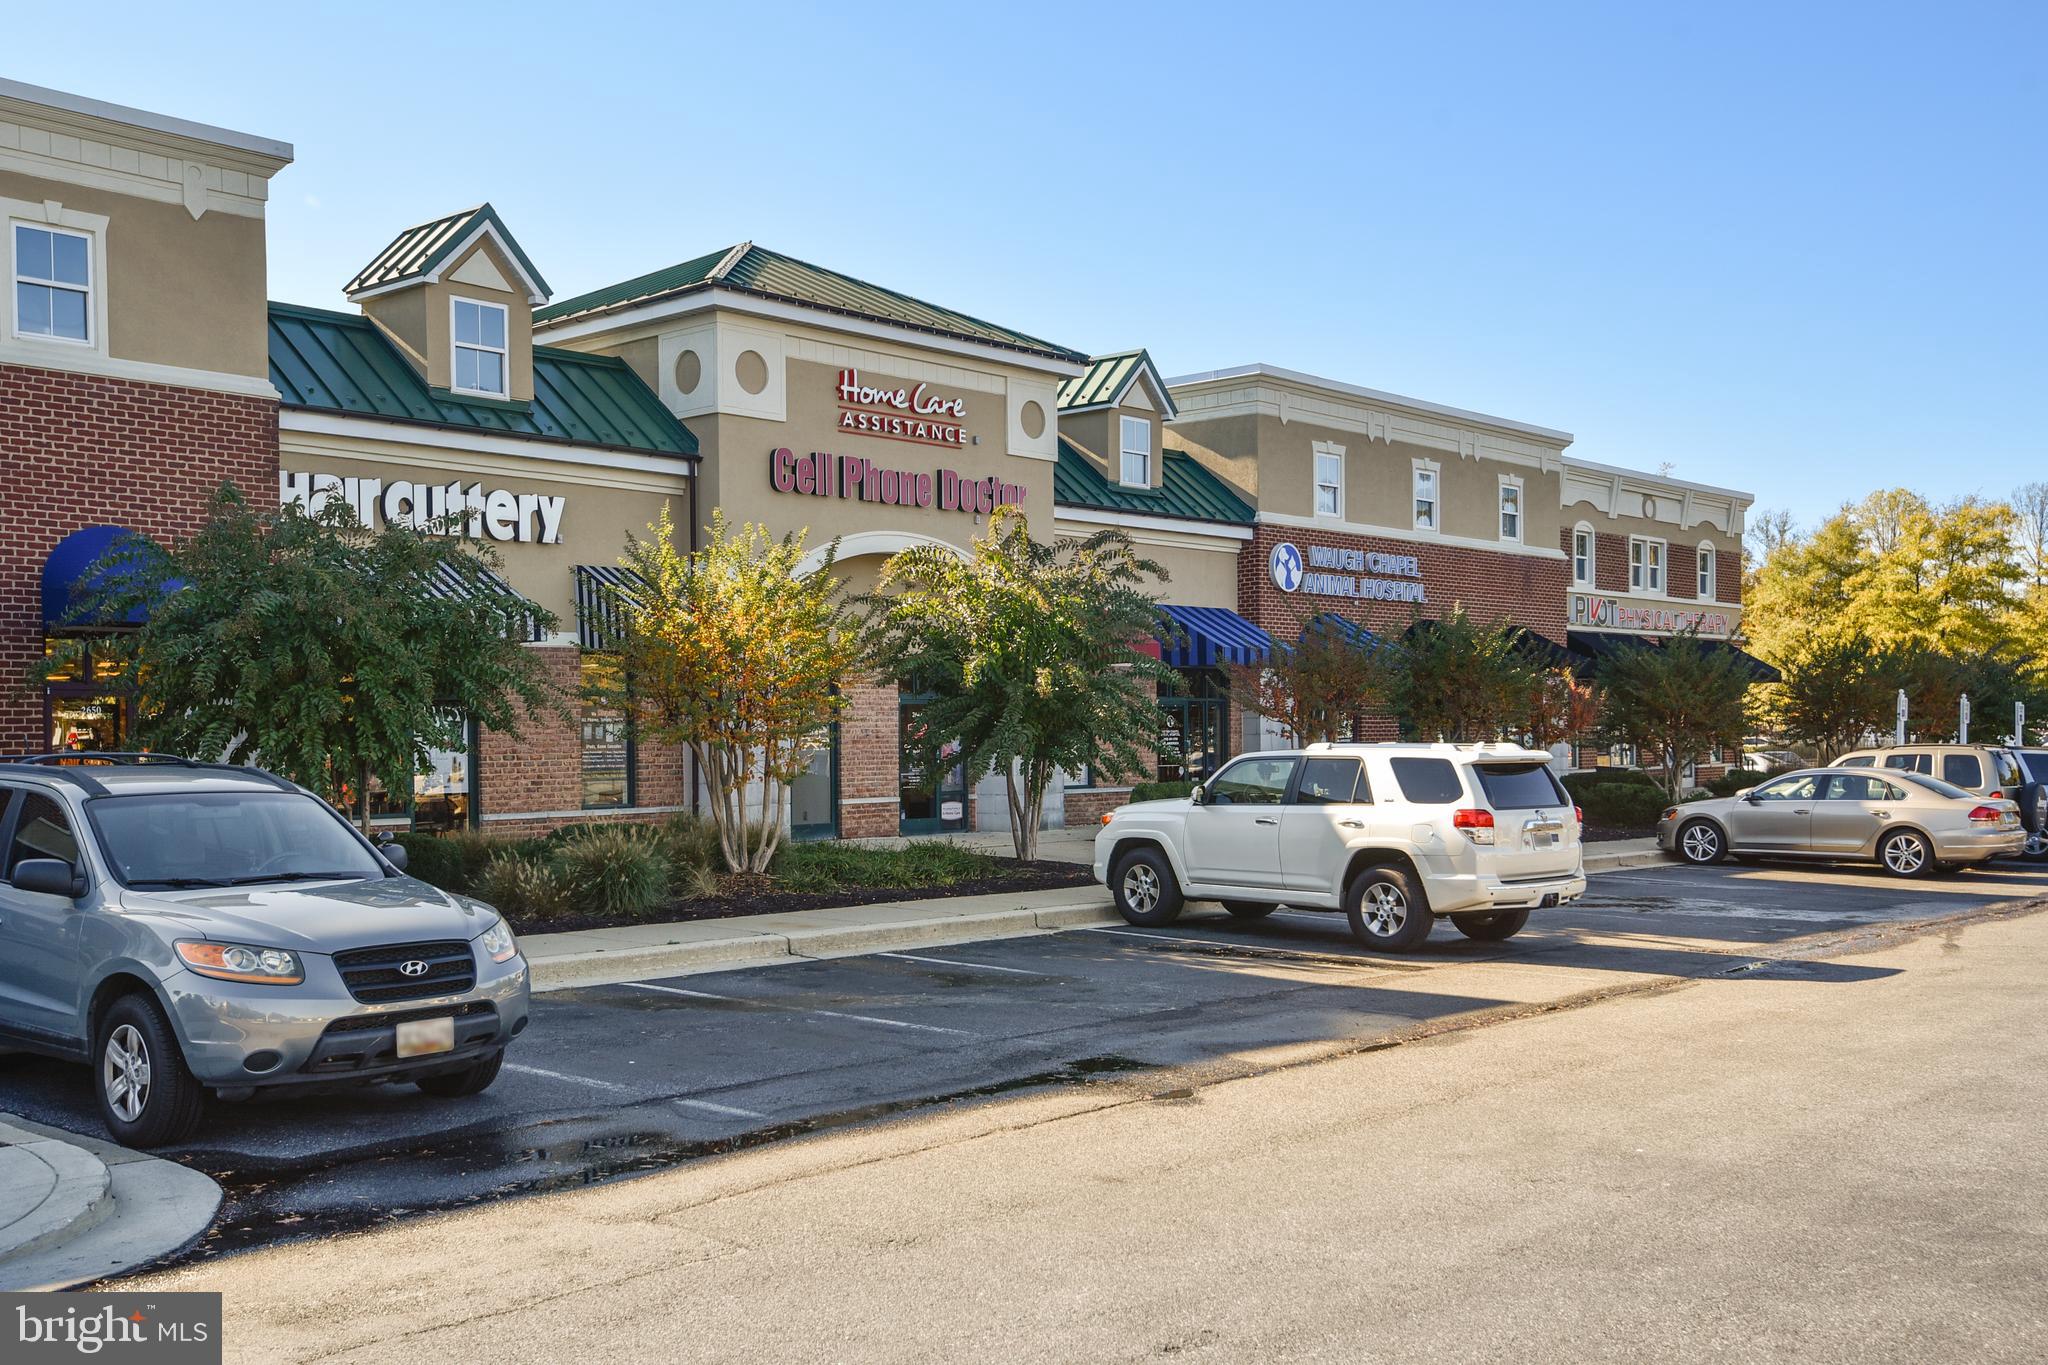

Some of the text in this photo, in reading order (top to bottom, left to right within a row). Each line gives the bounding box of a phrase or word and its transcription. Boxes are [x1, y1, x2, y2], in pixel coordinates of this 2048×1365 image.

[839, 367, 967, 418] Home Care
[841, 410, 968, 444] ASSISTANCE
[772, 446, 1027, 515] Cell Phone Doctor
[1309, 545, 1422, 578] WAUGH CHAPEL
[1305, 573, 1428, 604] ANIMAL HOSPITAL
[1575, 594, 1729, 634] PIVOT PHYSICAL THERAPY
[81, 706, 102, 714] 2650
